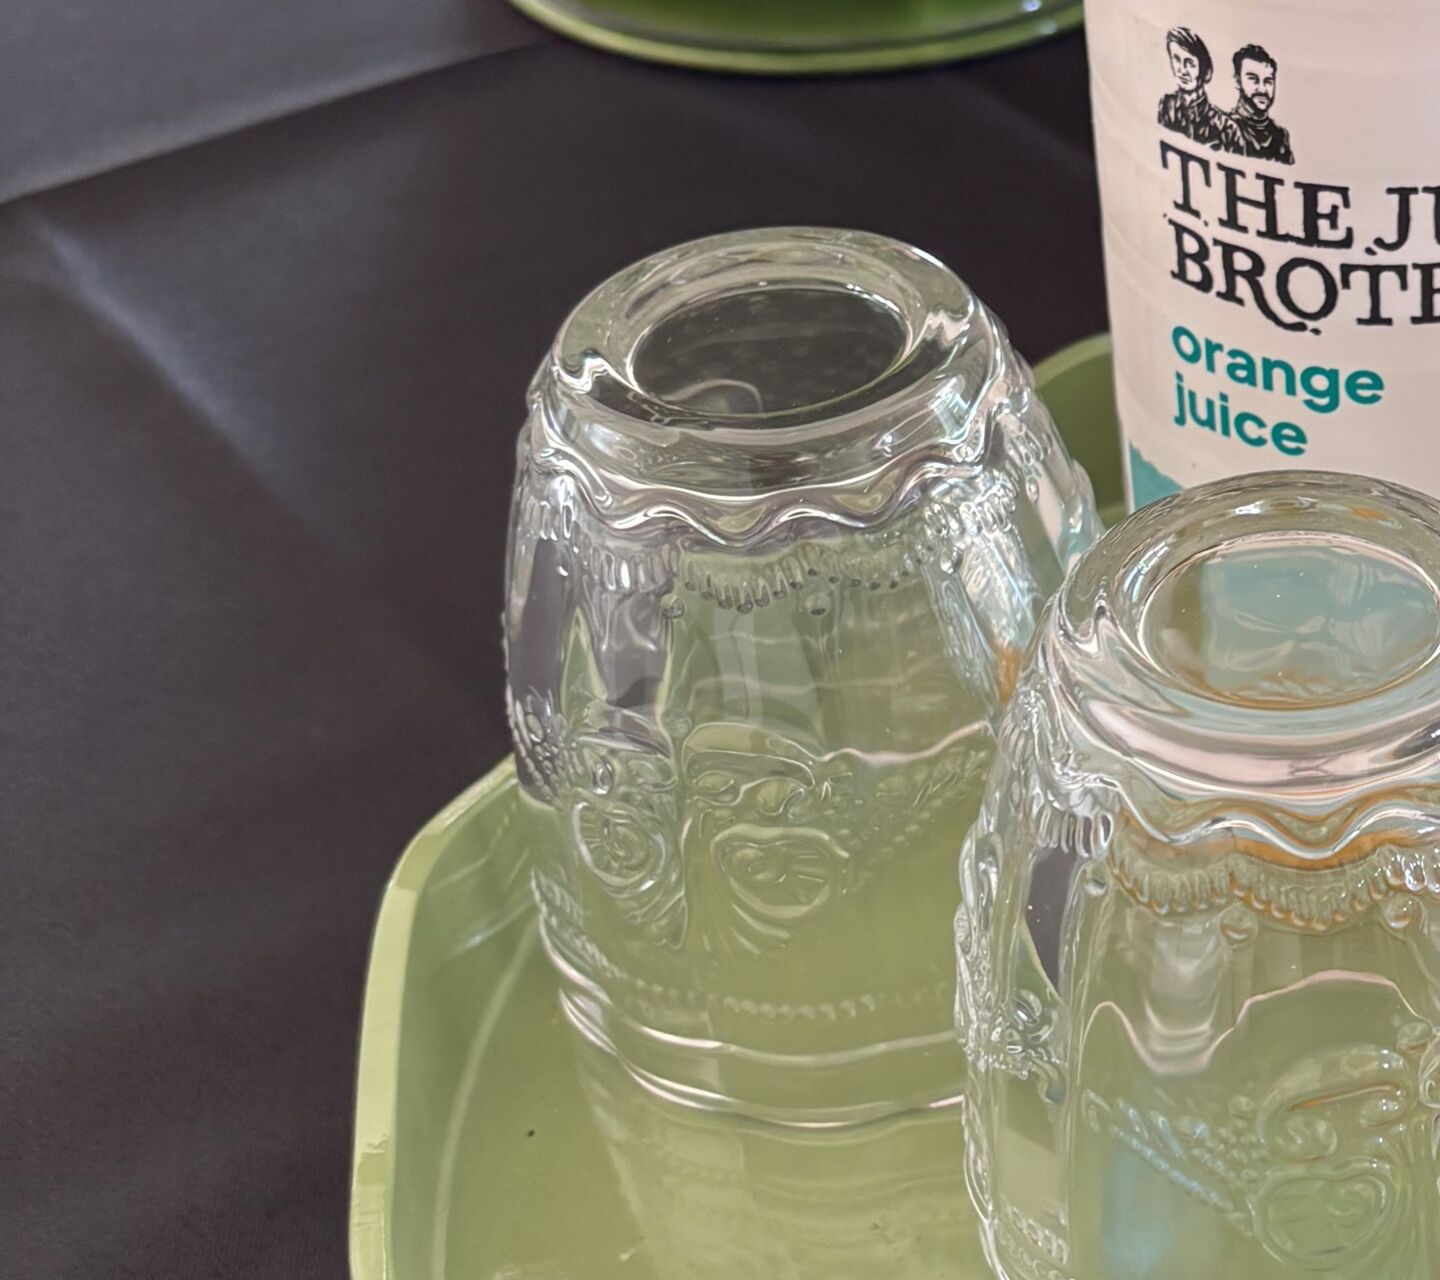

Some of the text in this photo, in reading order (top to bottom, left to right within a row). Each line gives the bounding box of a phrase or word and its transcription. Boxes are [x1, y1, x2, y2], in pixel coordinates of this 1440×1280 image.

[1159, 139, 1354, 252] THE
[1171, 324, 1385, 414] orange
[1173, 373, 1309, 457] juice
